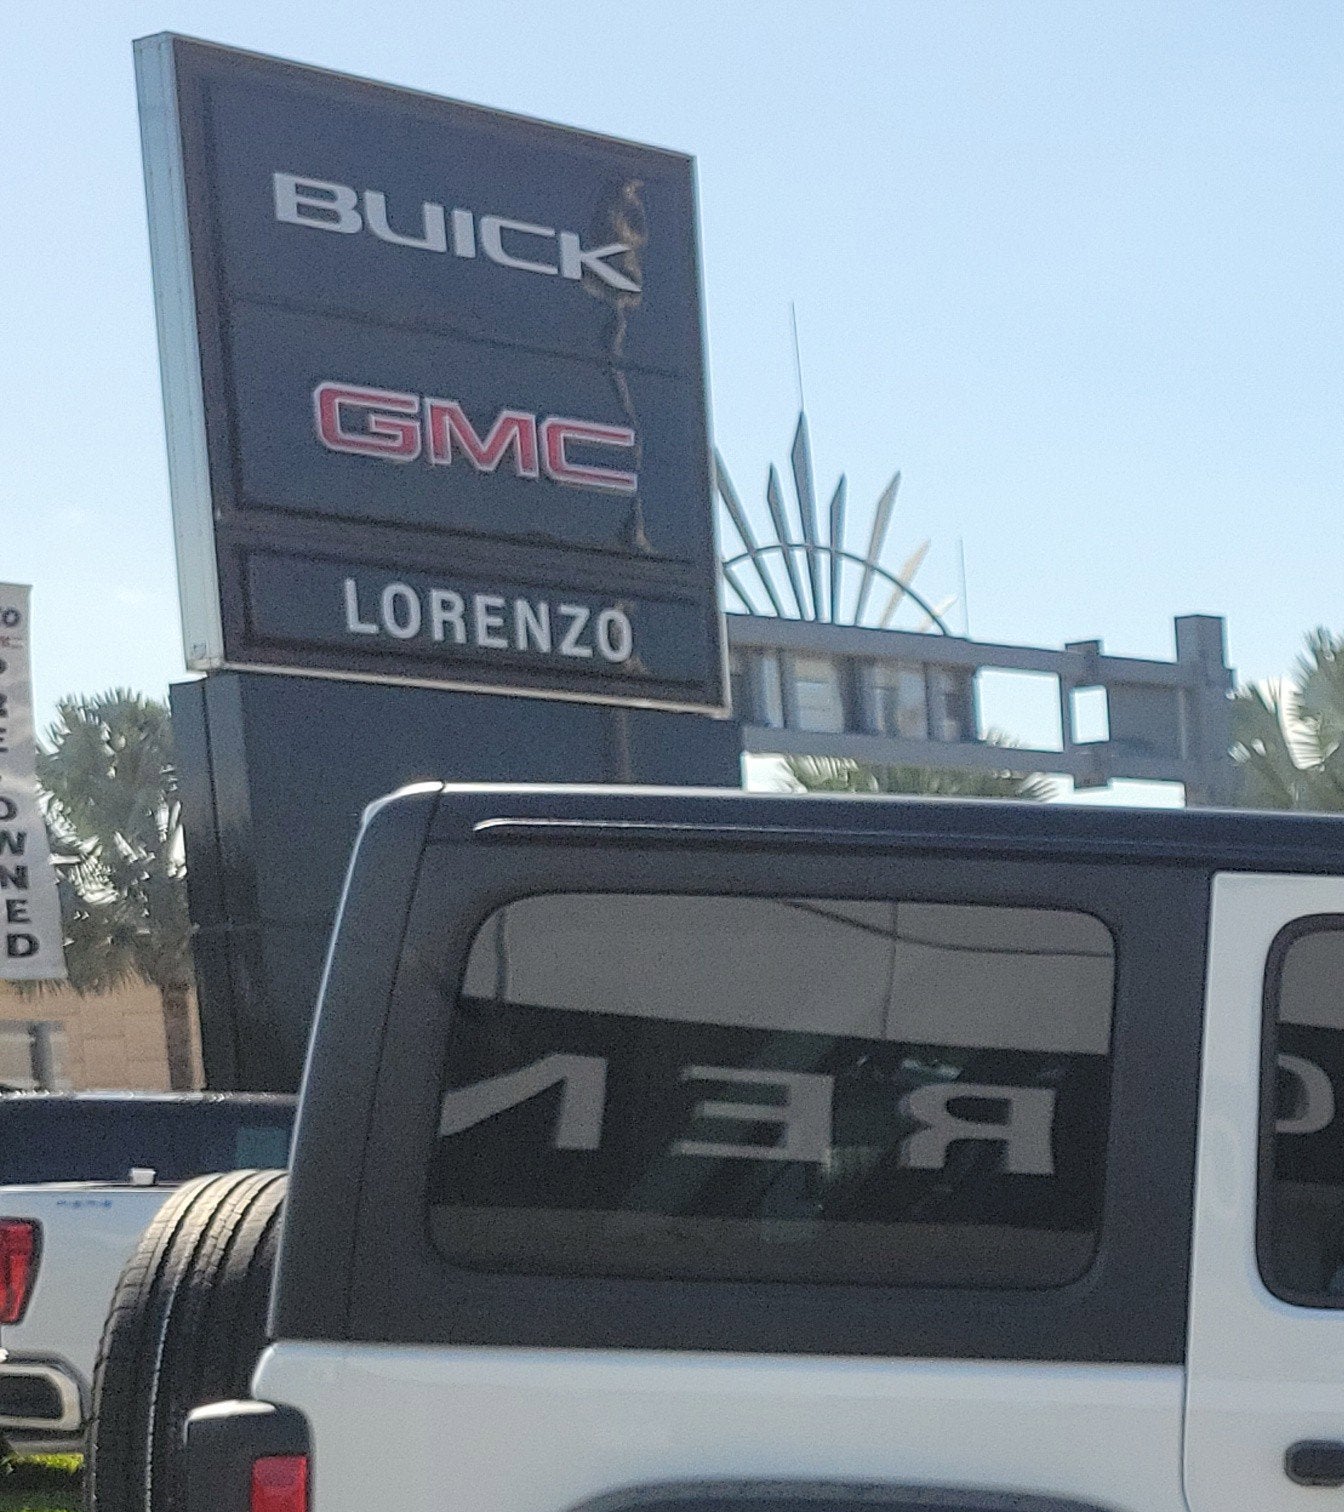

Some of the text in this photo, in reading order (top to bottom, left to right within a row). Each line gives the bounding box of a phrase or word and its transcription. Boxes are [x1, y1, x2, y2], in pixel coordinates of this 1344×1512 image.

[273, 171, 642, 293] BUICK
[313, 381, 638, 492] GMC
[345, 578, 635, 663] LORENZO
